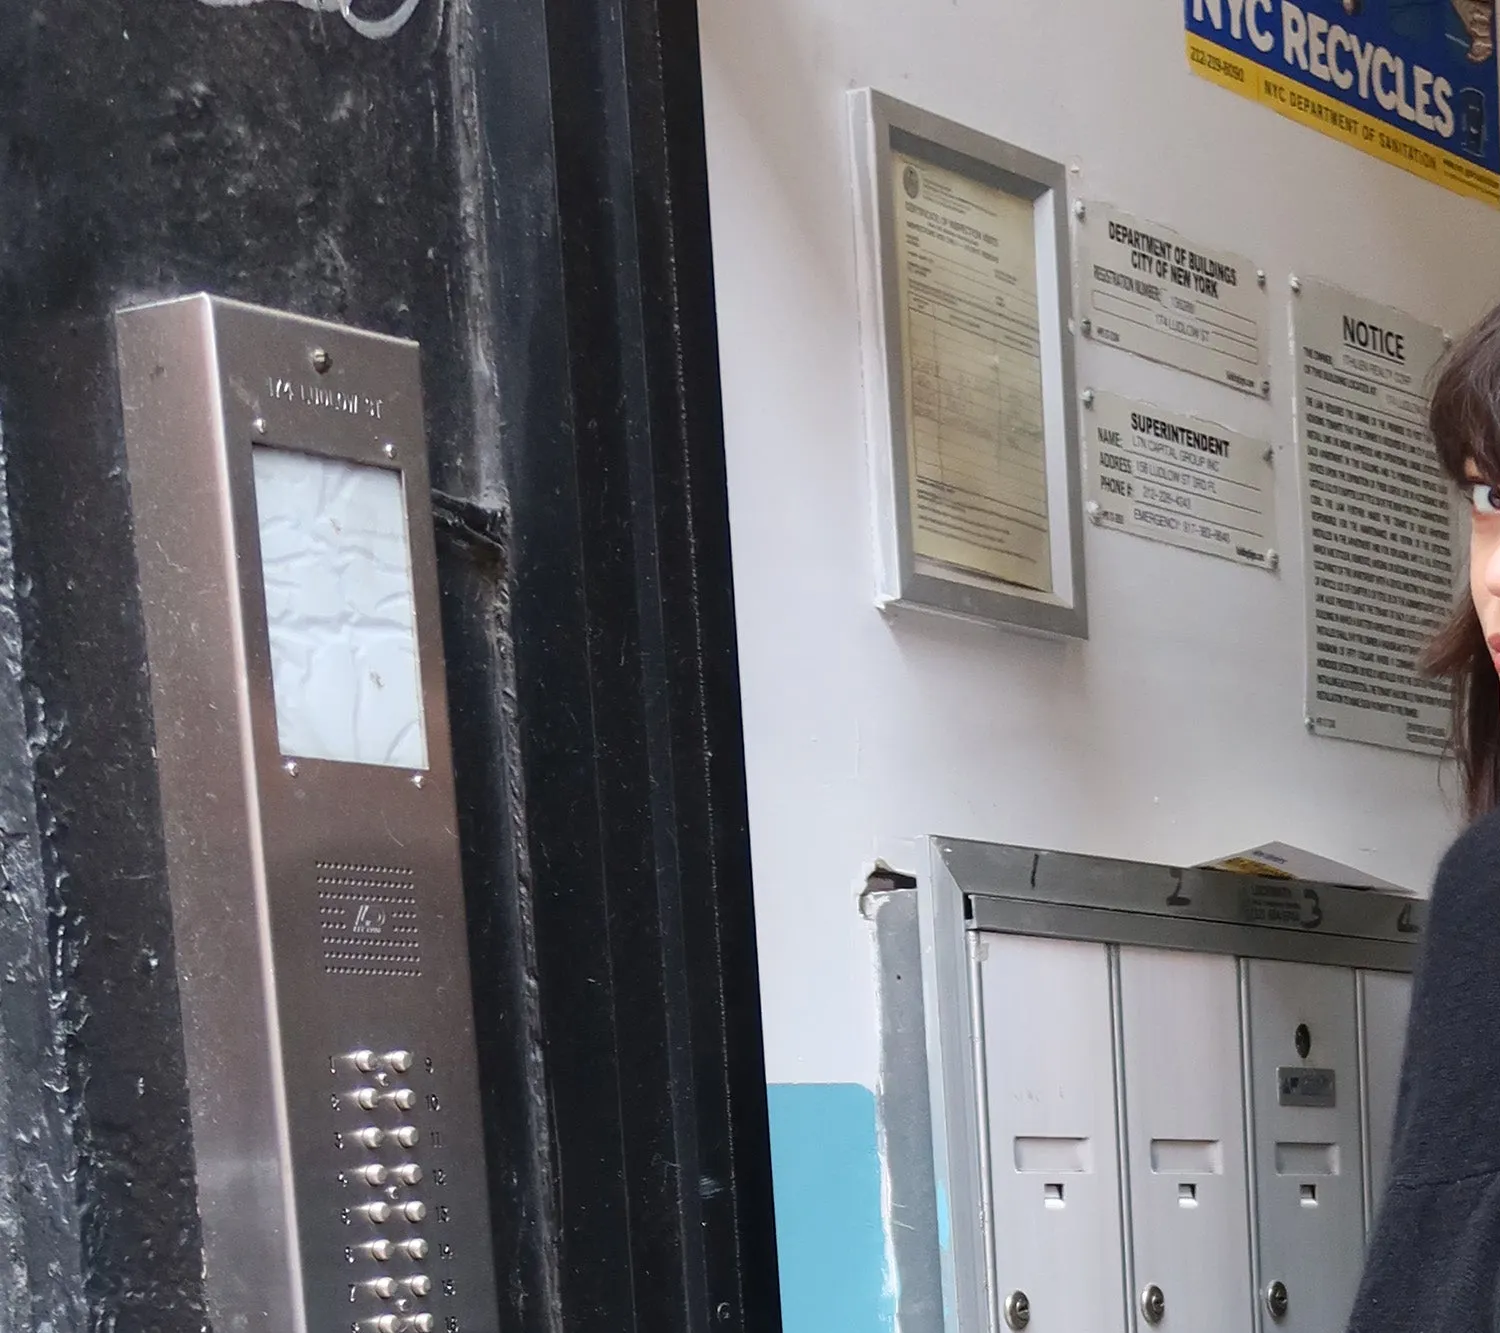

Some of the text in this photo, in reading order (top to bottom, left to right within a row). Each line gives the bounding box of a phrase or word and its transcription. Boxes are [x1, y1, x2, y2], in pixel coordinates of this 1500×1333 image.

[1281, 1, 1455, 138] RECYCLES
[1263, 79, 1437, 169] NYC DEPARTMENT OF SANITATION
[1108, 220, 1238, 287] DEPARTMENT OF BUILDINGS
[1131, 250, 1219, 300] CITY OF NEW YORK
[1342, 314, 1406, 361] NOTICE
[1131, 412, 1230, 458] SUPERINTENDENT
[1100, 475, 1126, 498] PHONE
[1030, 853, 1039, 890] 1
[1165, 868, 1192, 906] 2
[1300, 888, 1324, 929] 3
[425, 1057, 434, 1074] 9
[425, 1093, 441, 1112] 10
[430, 1131, 443, 1149] 11
[432, 1168, 447, 1186] 12
[348, 1283, 356, 1303] 7
